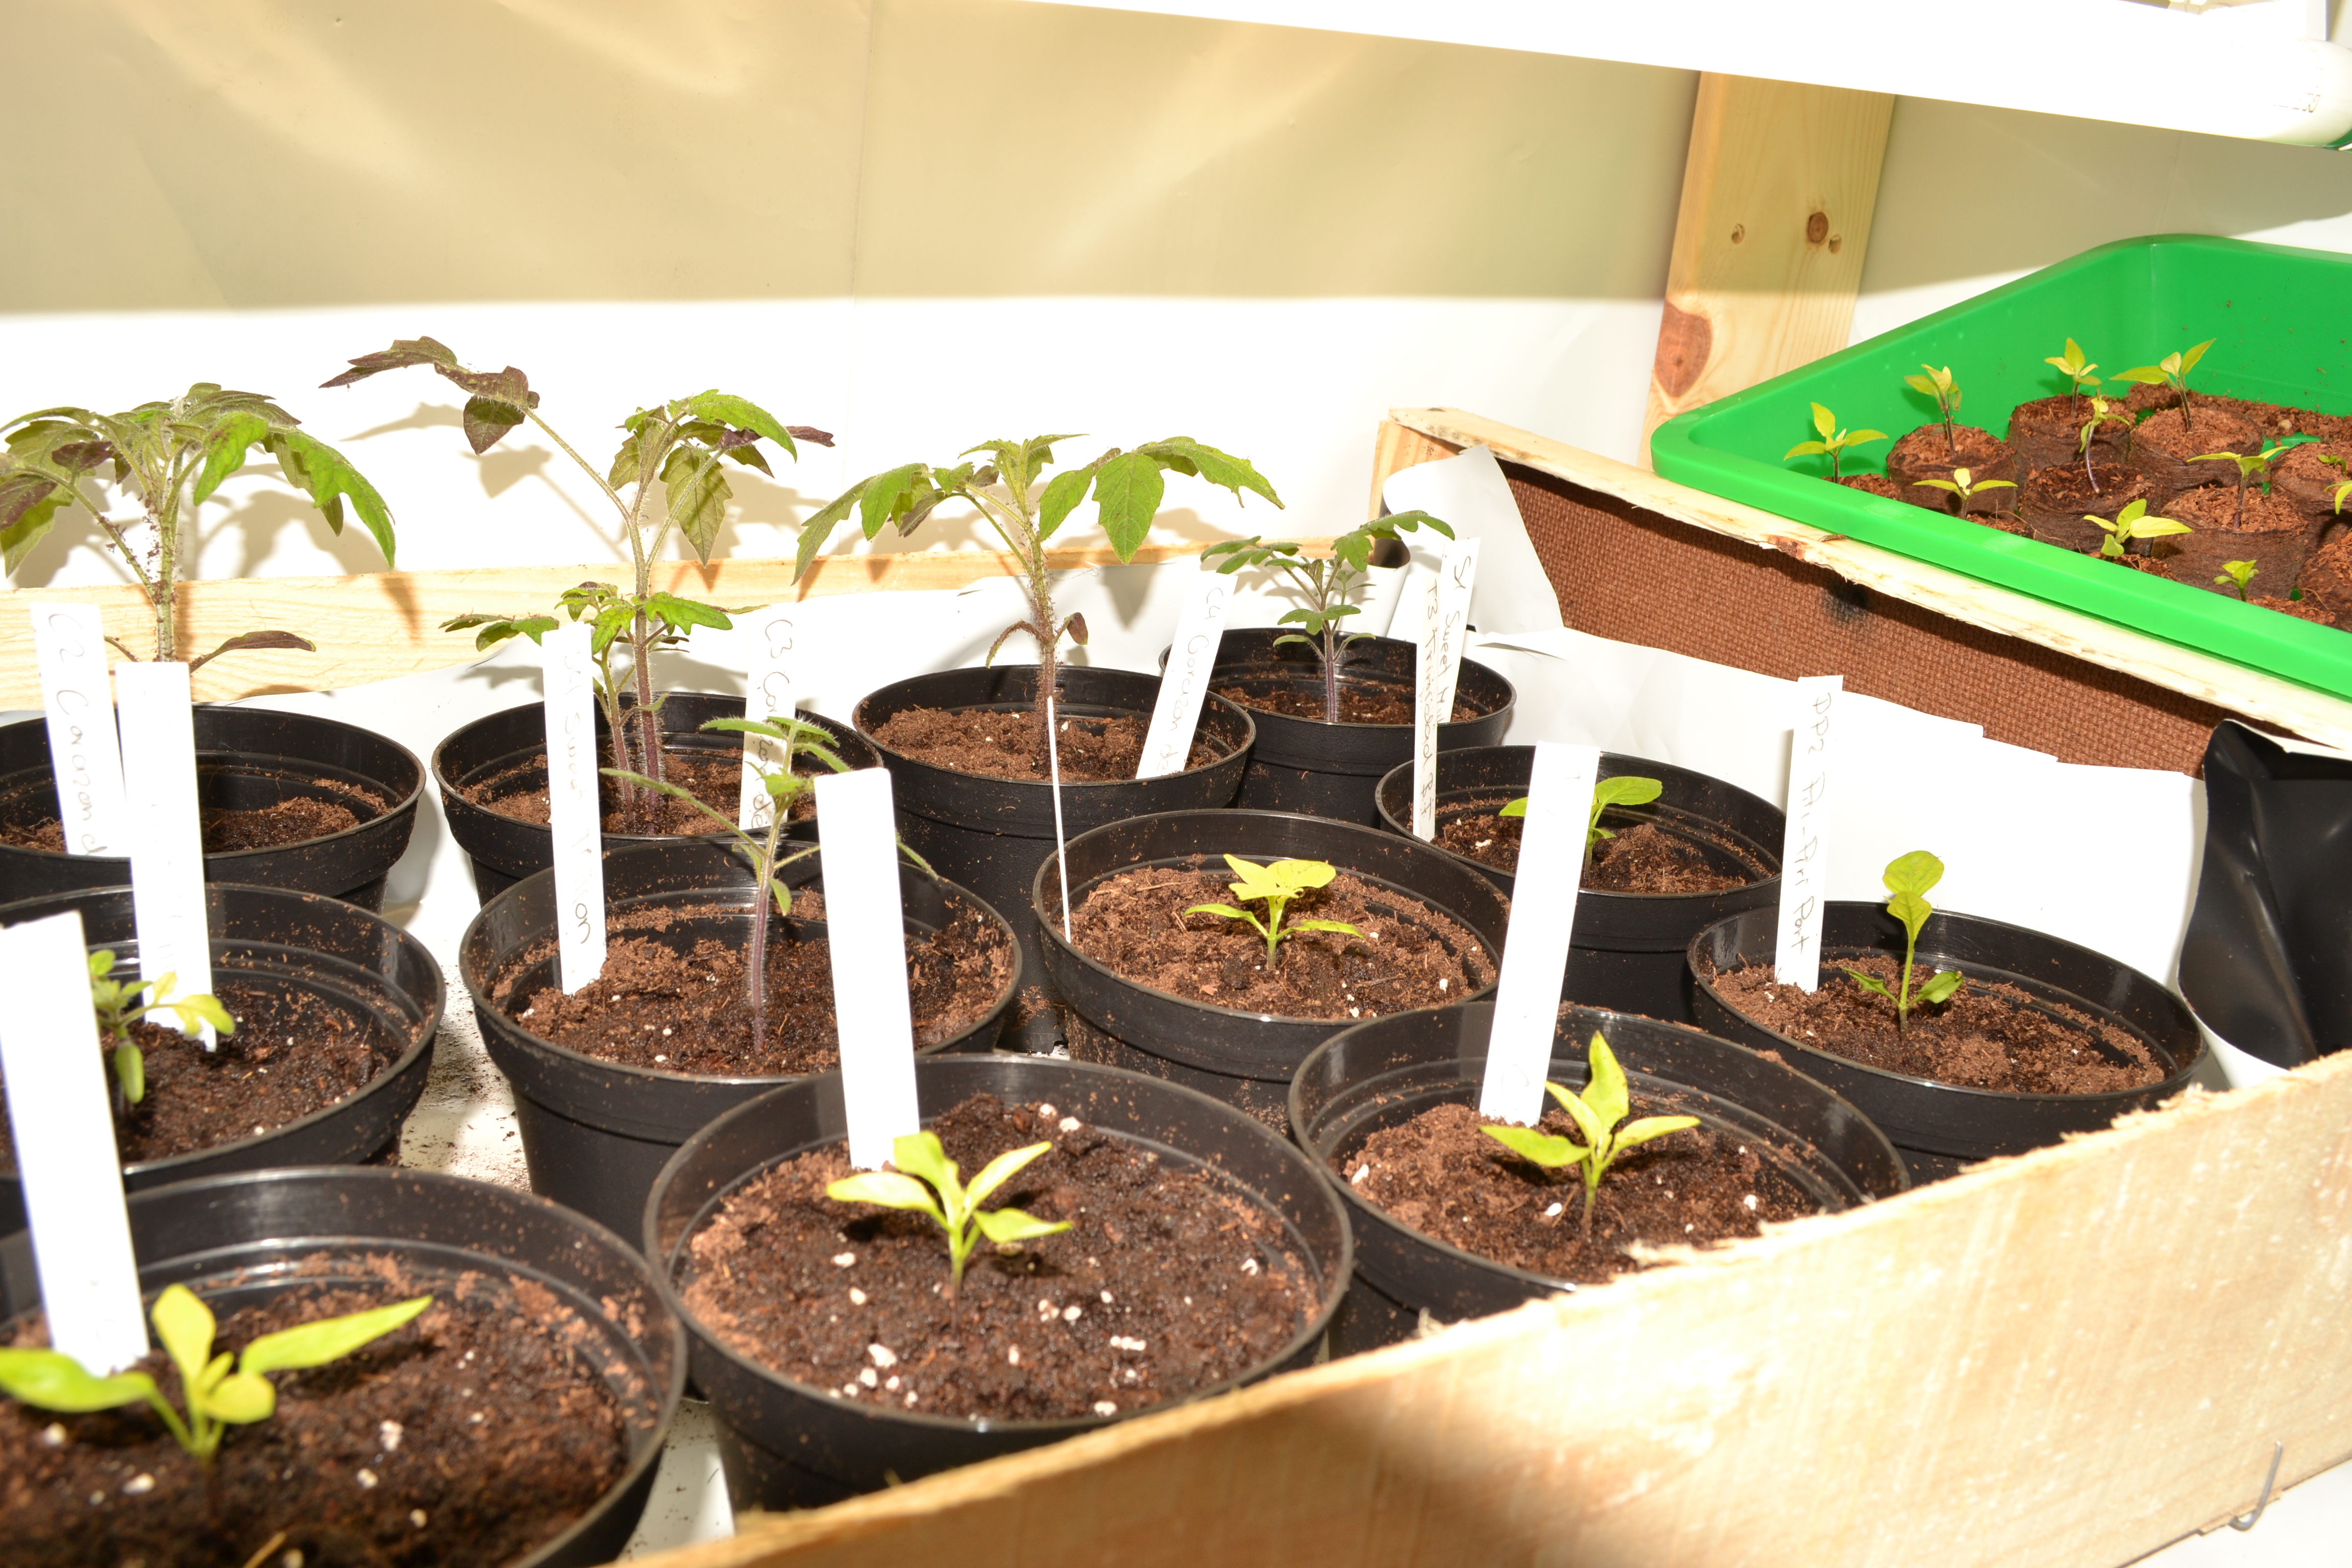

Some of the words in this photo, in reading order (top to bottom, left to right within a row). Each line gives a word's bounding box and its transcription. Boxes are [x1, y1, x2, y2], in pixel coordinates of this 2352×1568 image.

[1428, 579, 1438, 620] T3
[765, 619, 793, 658] C3
[1438, 611, 1460, 677] Sweet
[1422, 628, 1437, 769] Trinidad
[755, 671, 790, 781] Corzon
[1157, 744, 1179, 772] de
